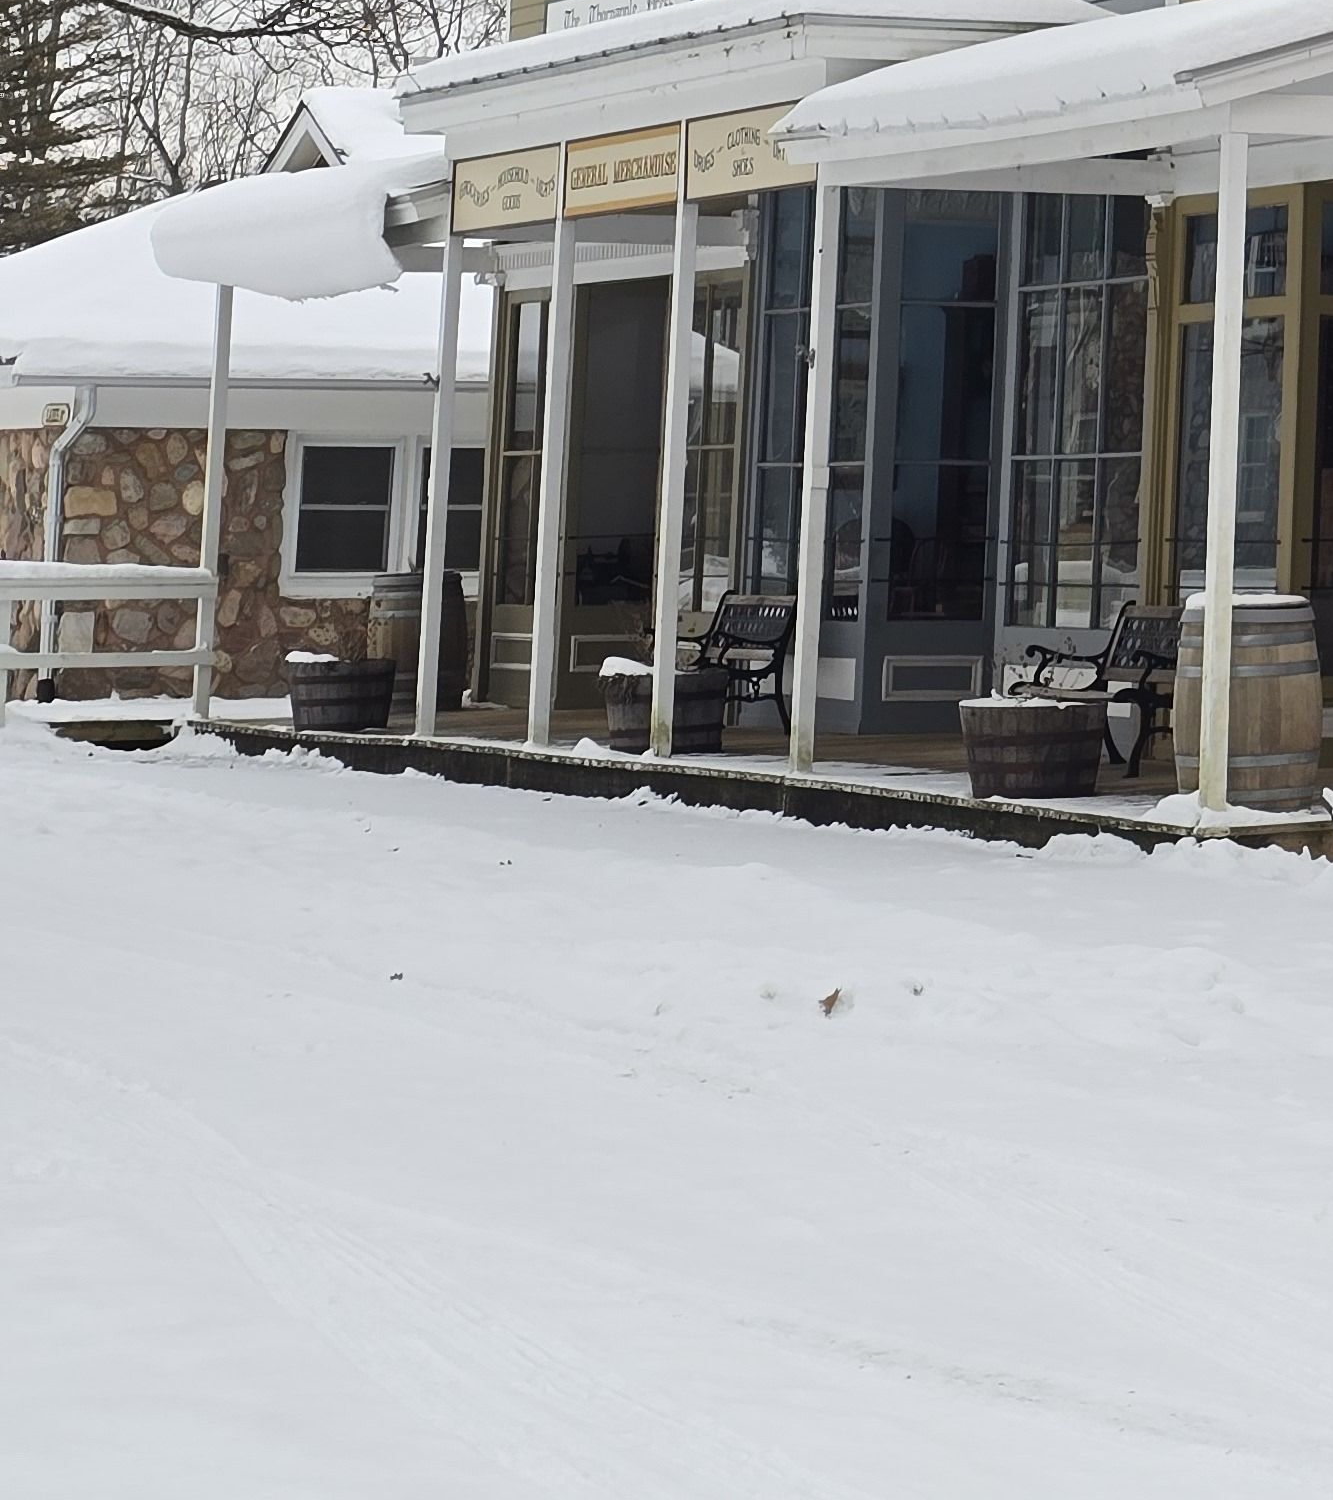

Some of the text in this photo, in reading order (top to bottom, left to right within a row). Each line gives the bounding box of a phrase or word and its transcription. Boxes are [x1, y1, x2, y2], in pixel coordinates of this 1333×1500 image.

[564, 8, 580, 29] The
[727, 127, 760, 150] CLOTHING
[571, 150, 677, 190] GENERAL MERCHANDISE
[732, 157, 754, 177] SHOES
